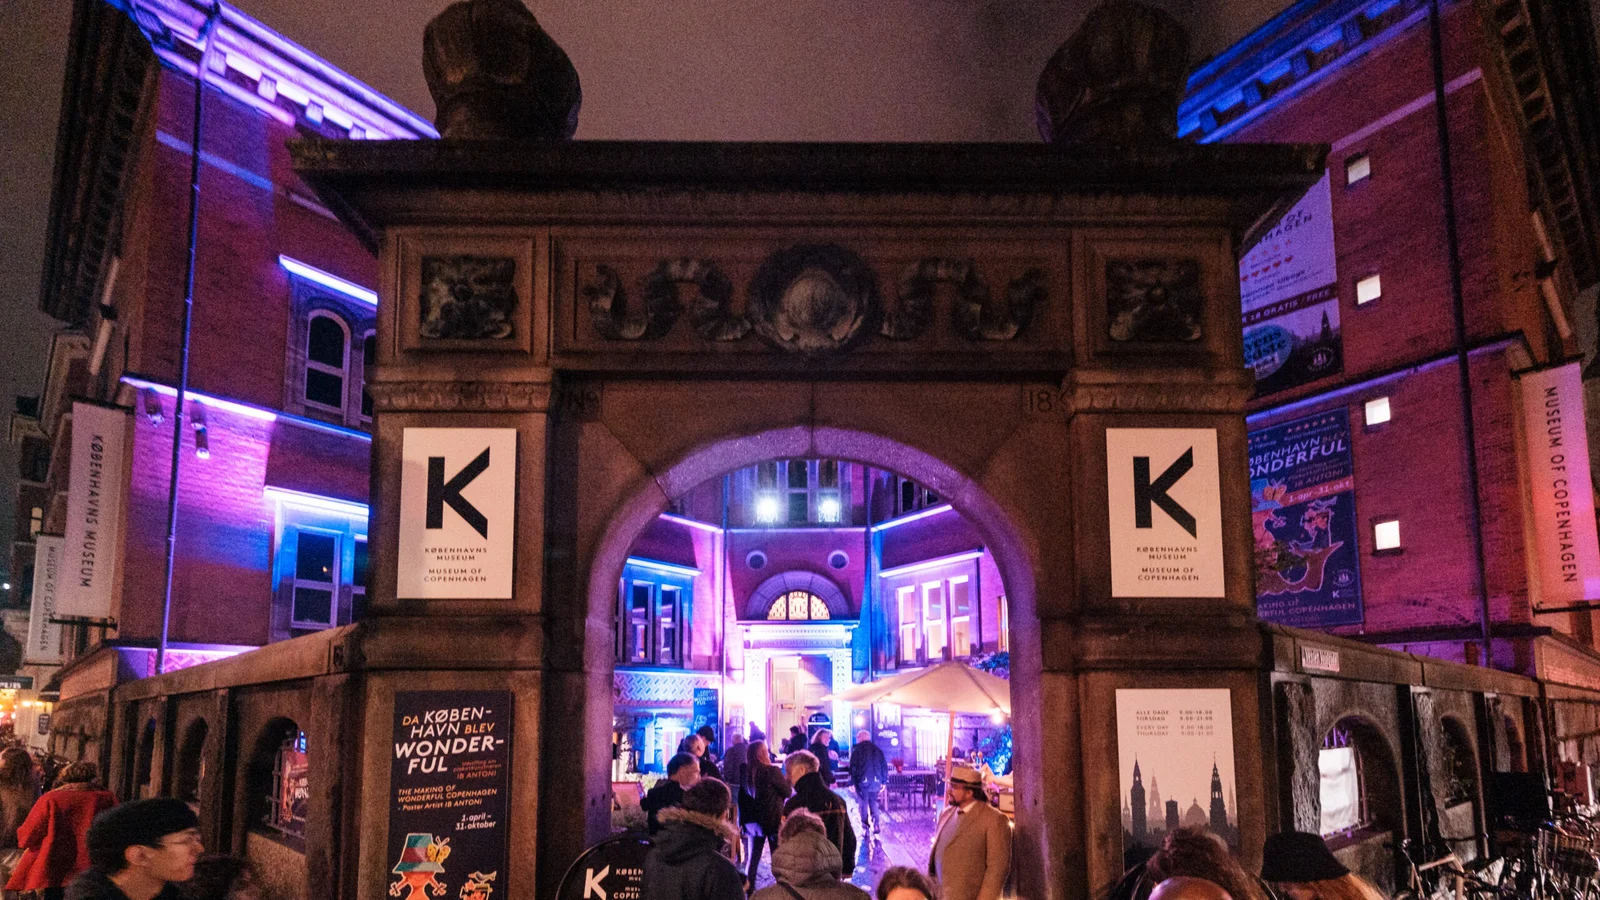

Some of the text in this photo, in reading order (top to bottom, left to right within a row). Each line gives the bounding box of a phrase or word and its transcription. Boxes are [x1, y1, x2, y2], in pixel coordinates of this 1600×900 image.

[1263, 300, 1298, 317] GRATIS
[425, 445, 491, 541] K
[1132, 445, 1198, 540] K
[1543, 386, 1578, 583] MUSEUM OF COPENHAGEN
[79, 434, 103, 588] KØBENHAVNS MUSEUM
[1332, 589, 1340, 599] K
[1288, 602, 1356, 614] COPENHAGEN
[402, 706, 492, 726] DA KØBEN-
[410, 722, 495, 739] HAVN BLEV
[395, 735, 504, 759] WONDER-
[407, 756, 448, 775] FUL
[466, 770, 497, 779] ANTONI
[397, 788, 498, 803] WONDERFUL COPENHAGEN
[398, 784, 457, 796] THE MAKING OF
[424, 801, 443, 809] Artist
[453, 798, 483, 807] ANTONI
[583, 864, 610, 900] K
